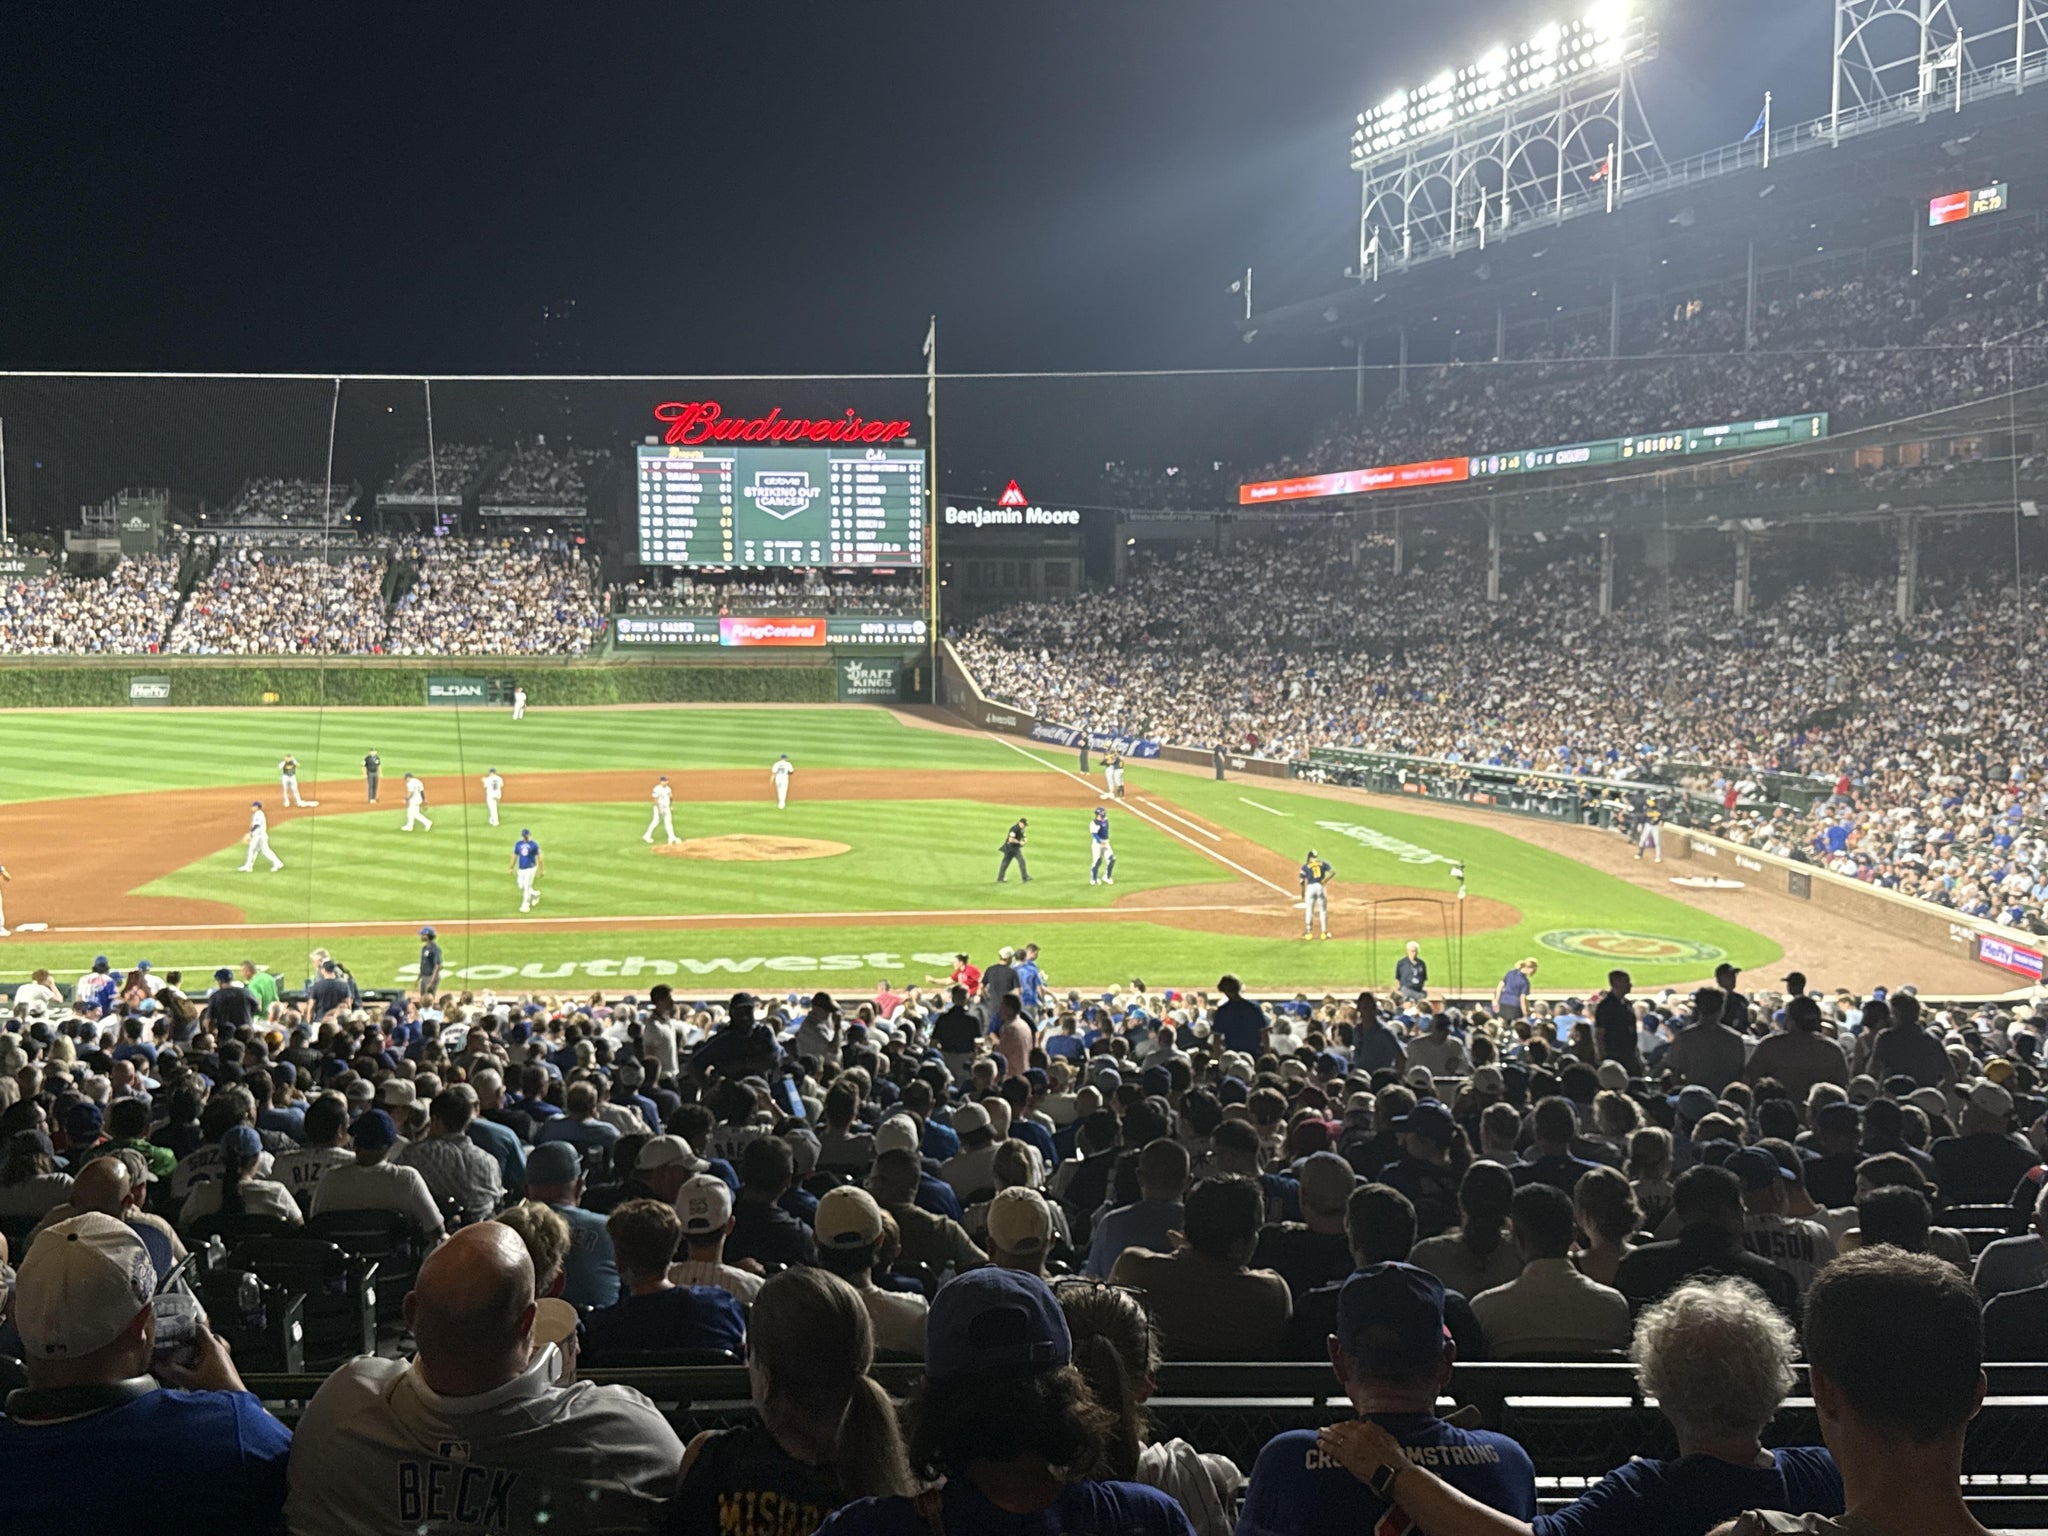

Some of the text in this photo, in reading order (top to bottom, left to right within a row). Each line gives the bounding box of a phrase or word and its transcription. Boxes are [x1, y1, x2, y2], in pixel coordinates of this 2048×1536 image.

[654, 401, 911, 445] Budweiser
[744, 487, 821, 498] STRIKING OUT
[760, 497, 805, 506] CANCER
[945, 506, 1080, 528] Benjamin Moore
[732, 624, 816, 640] RingCentral
[851, 669, 894, 680] DRAFT
[853, 678, 892, 687] KINGS
[430, 685, 481, 696] SLOAN
[847, 687, 896, 695] SPORTSBOOK
[1984, 941, 2011, 963] Hefty
[292, 1163, 322, 1183] RIZ
[1743, 1231, 1814, 1262] AWSON
[397, 1460, 522, 1531] BECK
